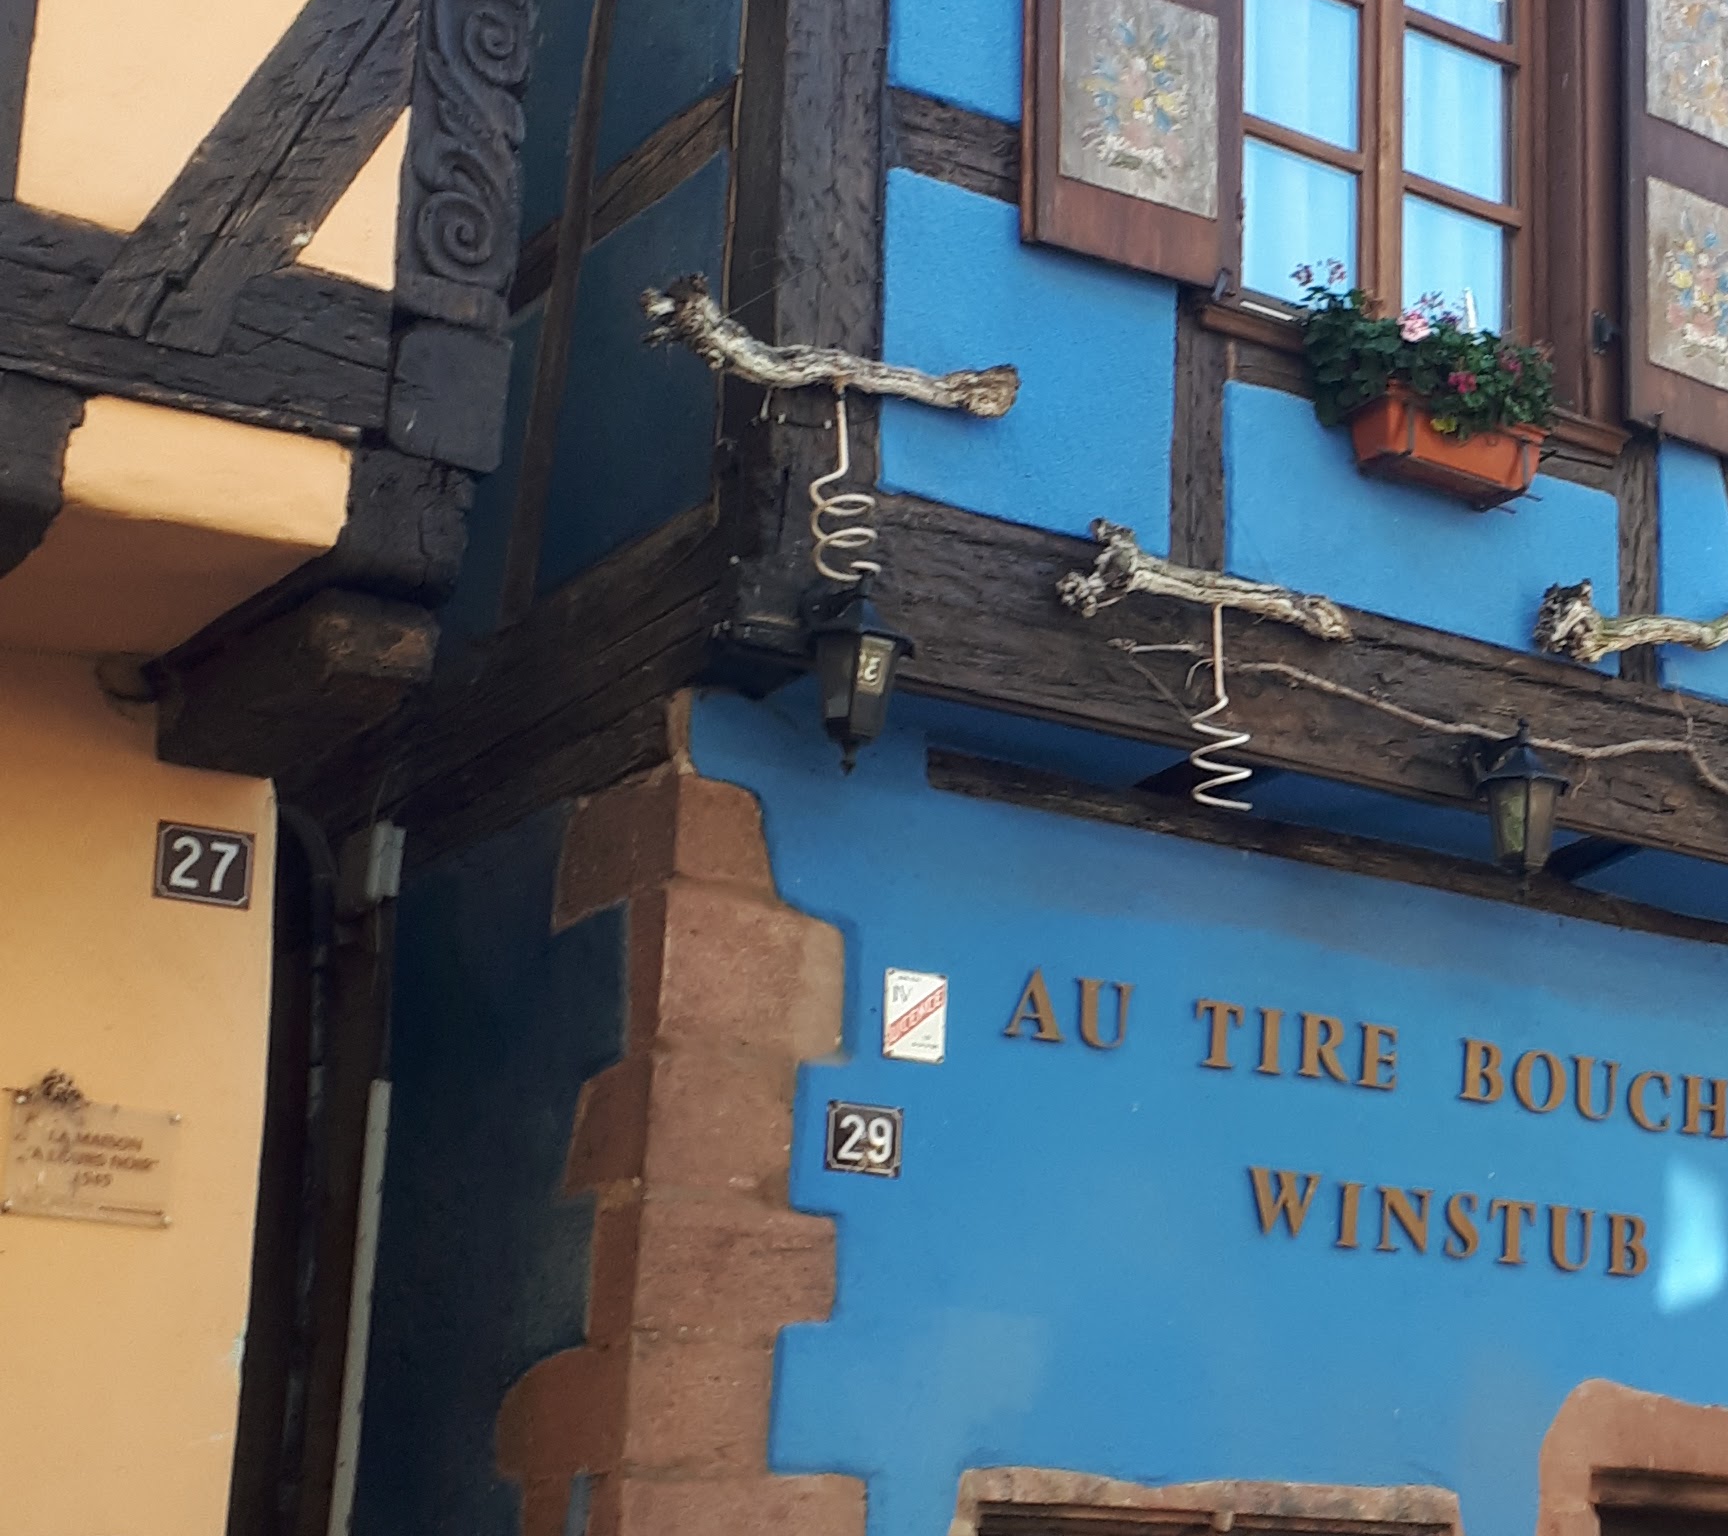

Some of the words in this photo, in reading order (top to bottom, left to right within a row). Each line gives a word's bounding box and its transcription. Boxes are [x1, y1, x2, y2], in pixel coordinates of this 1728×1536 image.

[168, 835, 240, 894] 27
[1003, 965, 1135, 1050] AU
[1195, 998, 1398, 1091] TIRE
[837, 1114, 894, 1164] 29
[1248, 1166, 1649, 1278] WINSTUB
